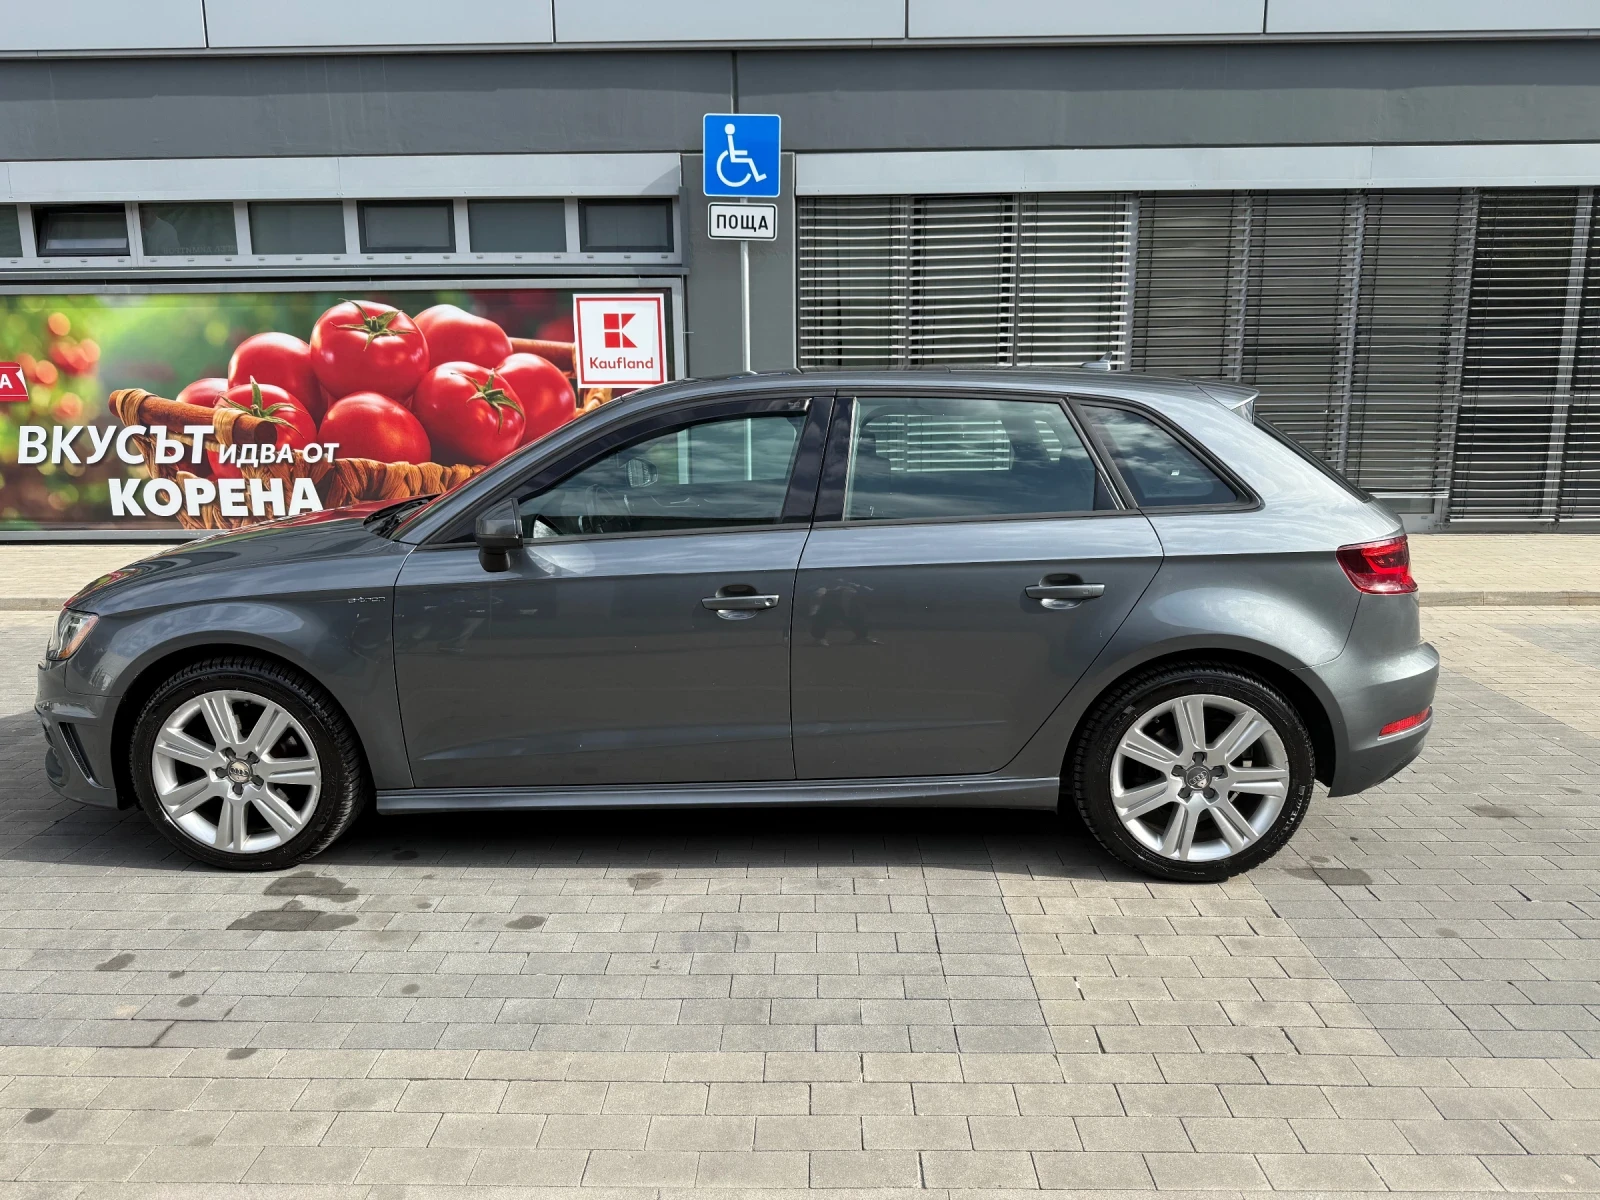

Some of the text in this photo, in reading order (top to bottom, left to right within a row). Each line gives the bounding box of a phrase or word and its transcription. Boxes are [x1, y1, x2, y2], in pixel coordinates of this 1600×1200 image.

[716, 214, 769, 232] ПОЩА
[589, 356, 654, 369] Kaufland
[17, 425, 340, 468] ВКУСЪТ ИДВА ОТ
[108, 477, 324, 517] КОРЕНА
